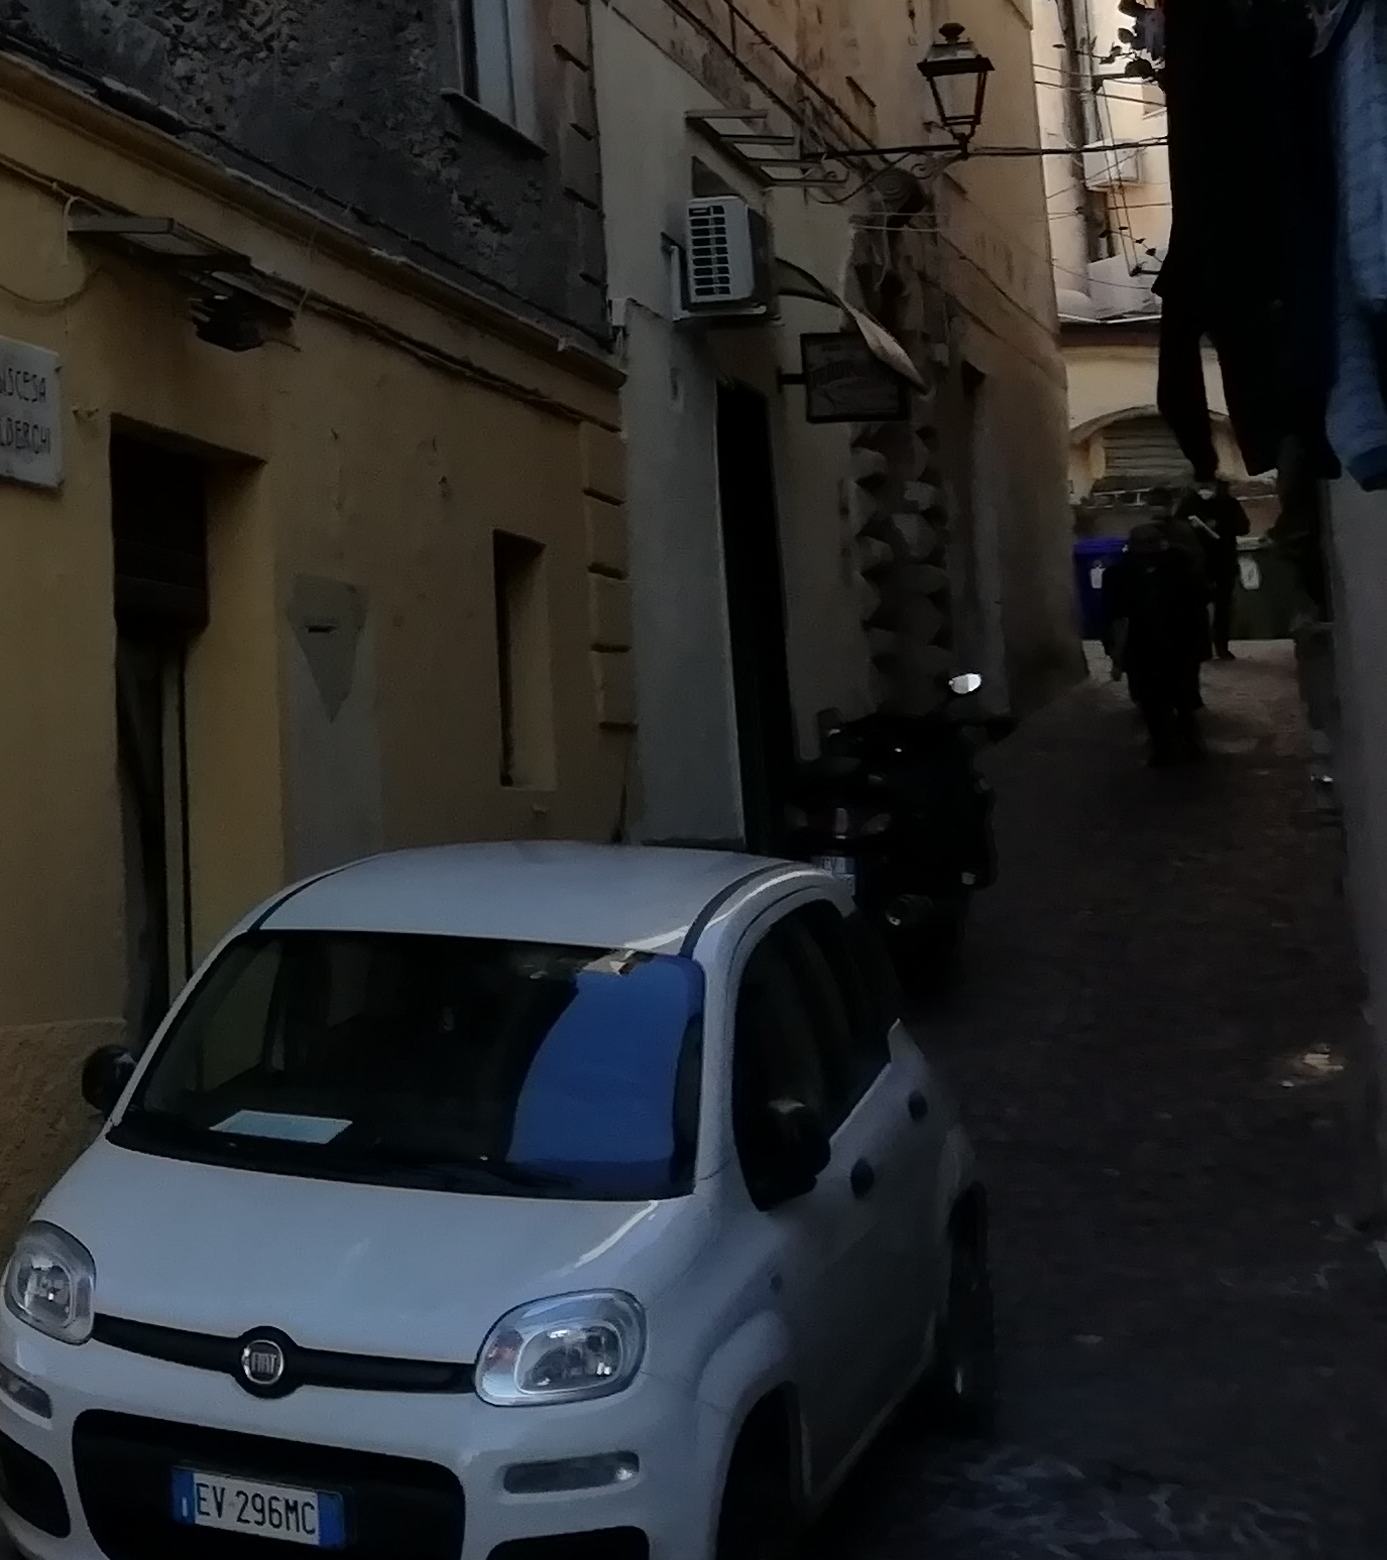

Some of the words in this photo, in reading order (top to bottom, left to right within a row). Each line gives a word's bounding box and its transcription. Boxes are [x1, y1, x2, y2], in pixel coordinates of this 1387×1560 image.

[250, 1351, 278, 1375] FIAT
[196, 1483, 225, 1519] EV
[236, 1490, 317, 1536] 296MC
